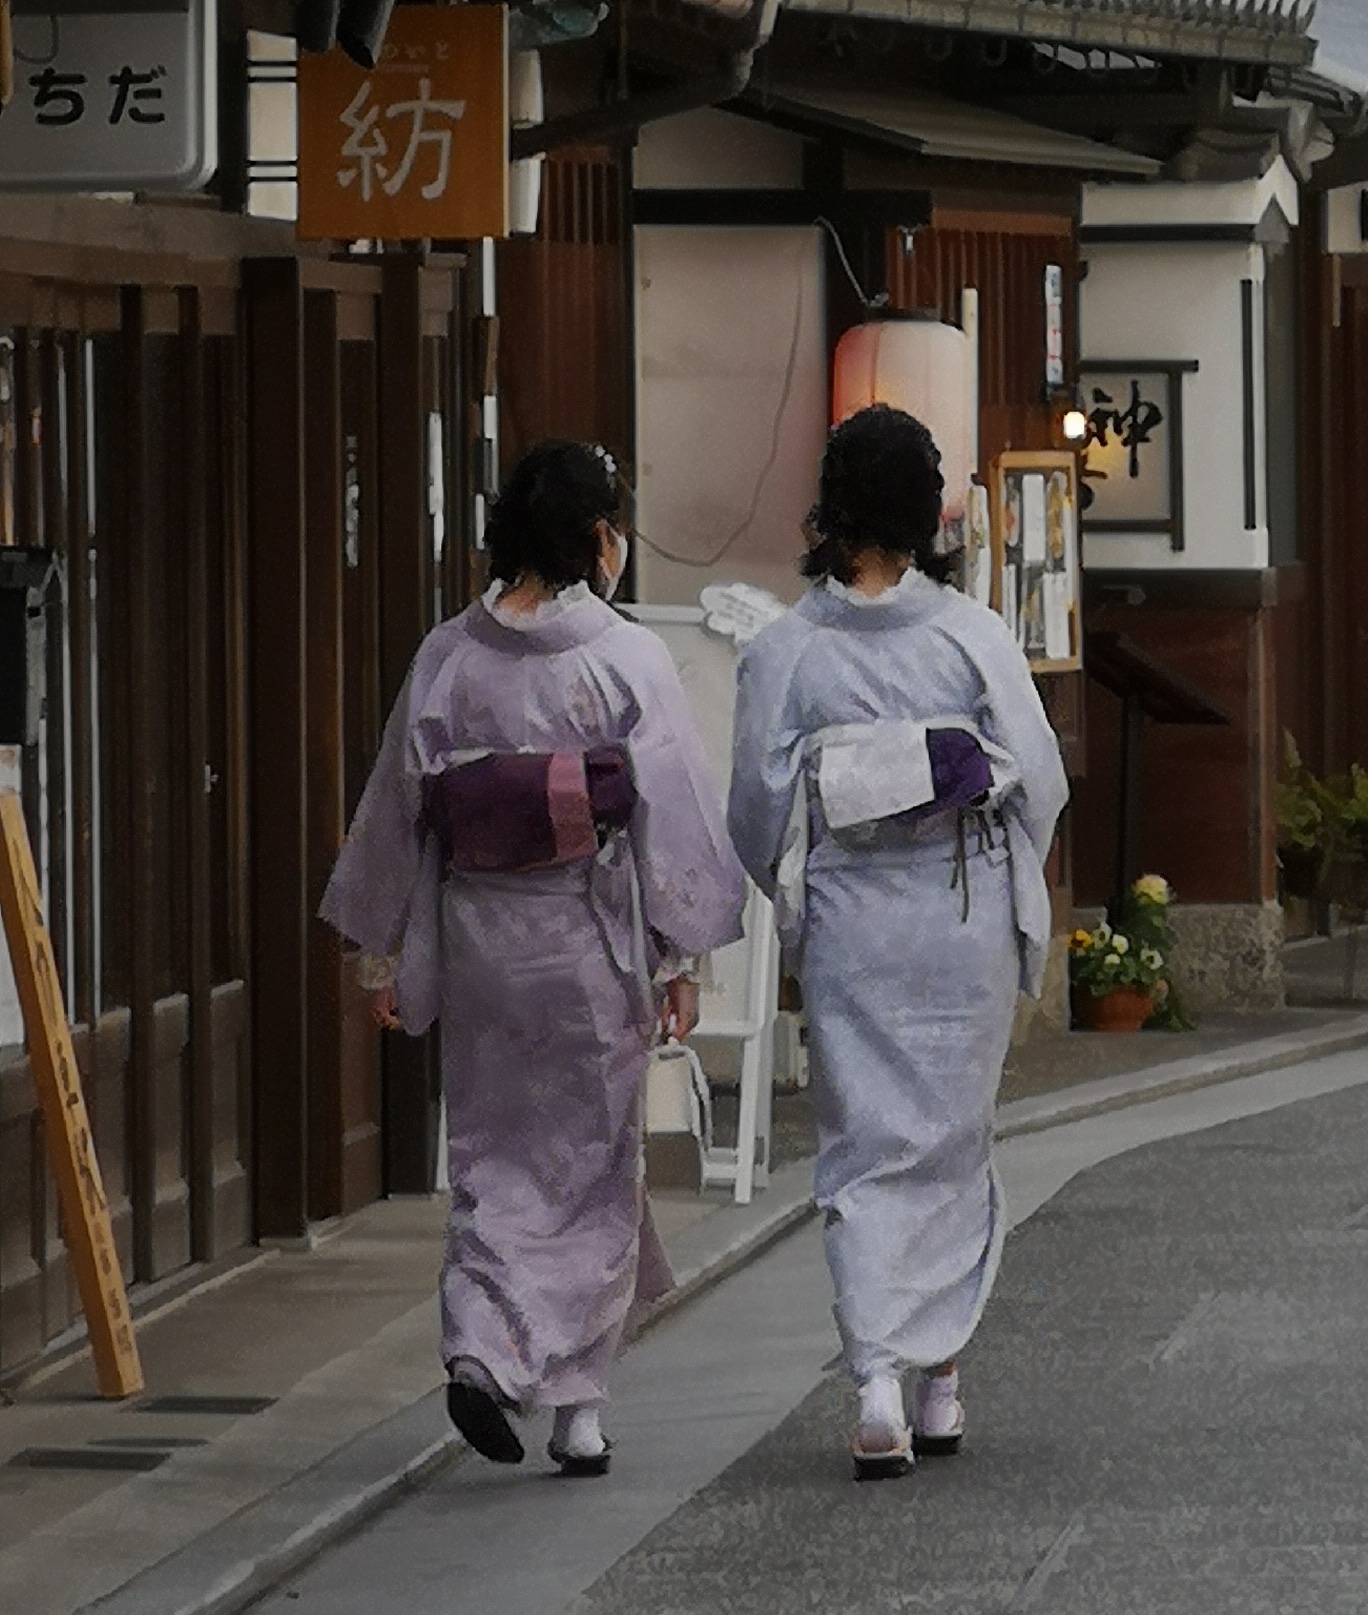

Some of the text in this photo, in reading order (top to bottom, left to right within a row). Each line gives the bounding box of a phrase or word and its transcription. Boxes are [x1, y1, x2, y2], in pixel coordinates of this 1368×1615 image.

[28, 64, 168, 126] ちだ
[336, 77, 467, 201] 紡
[1080, 379, 1164, 511] 神
